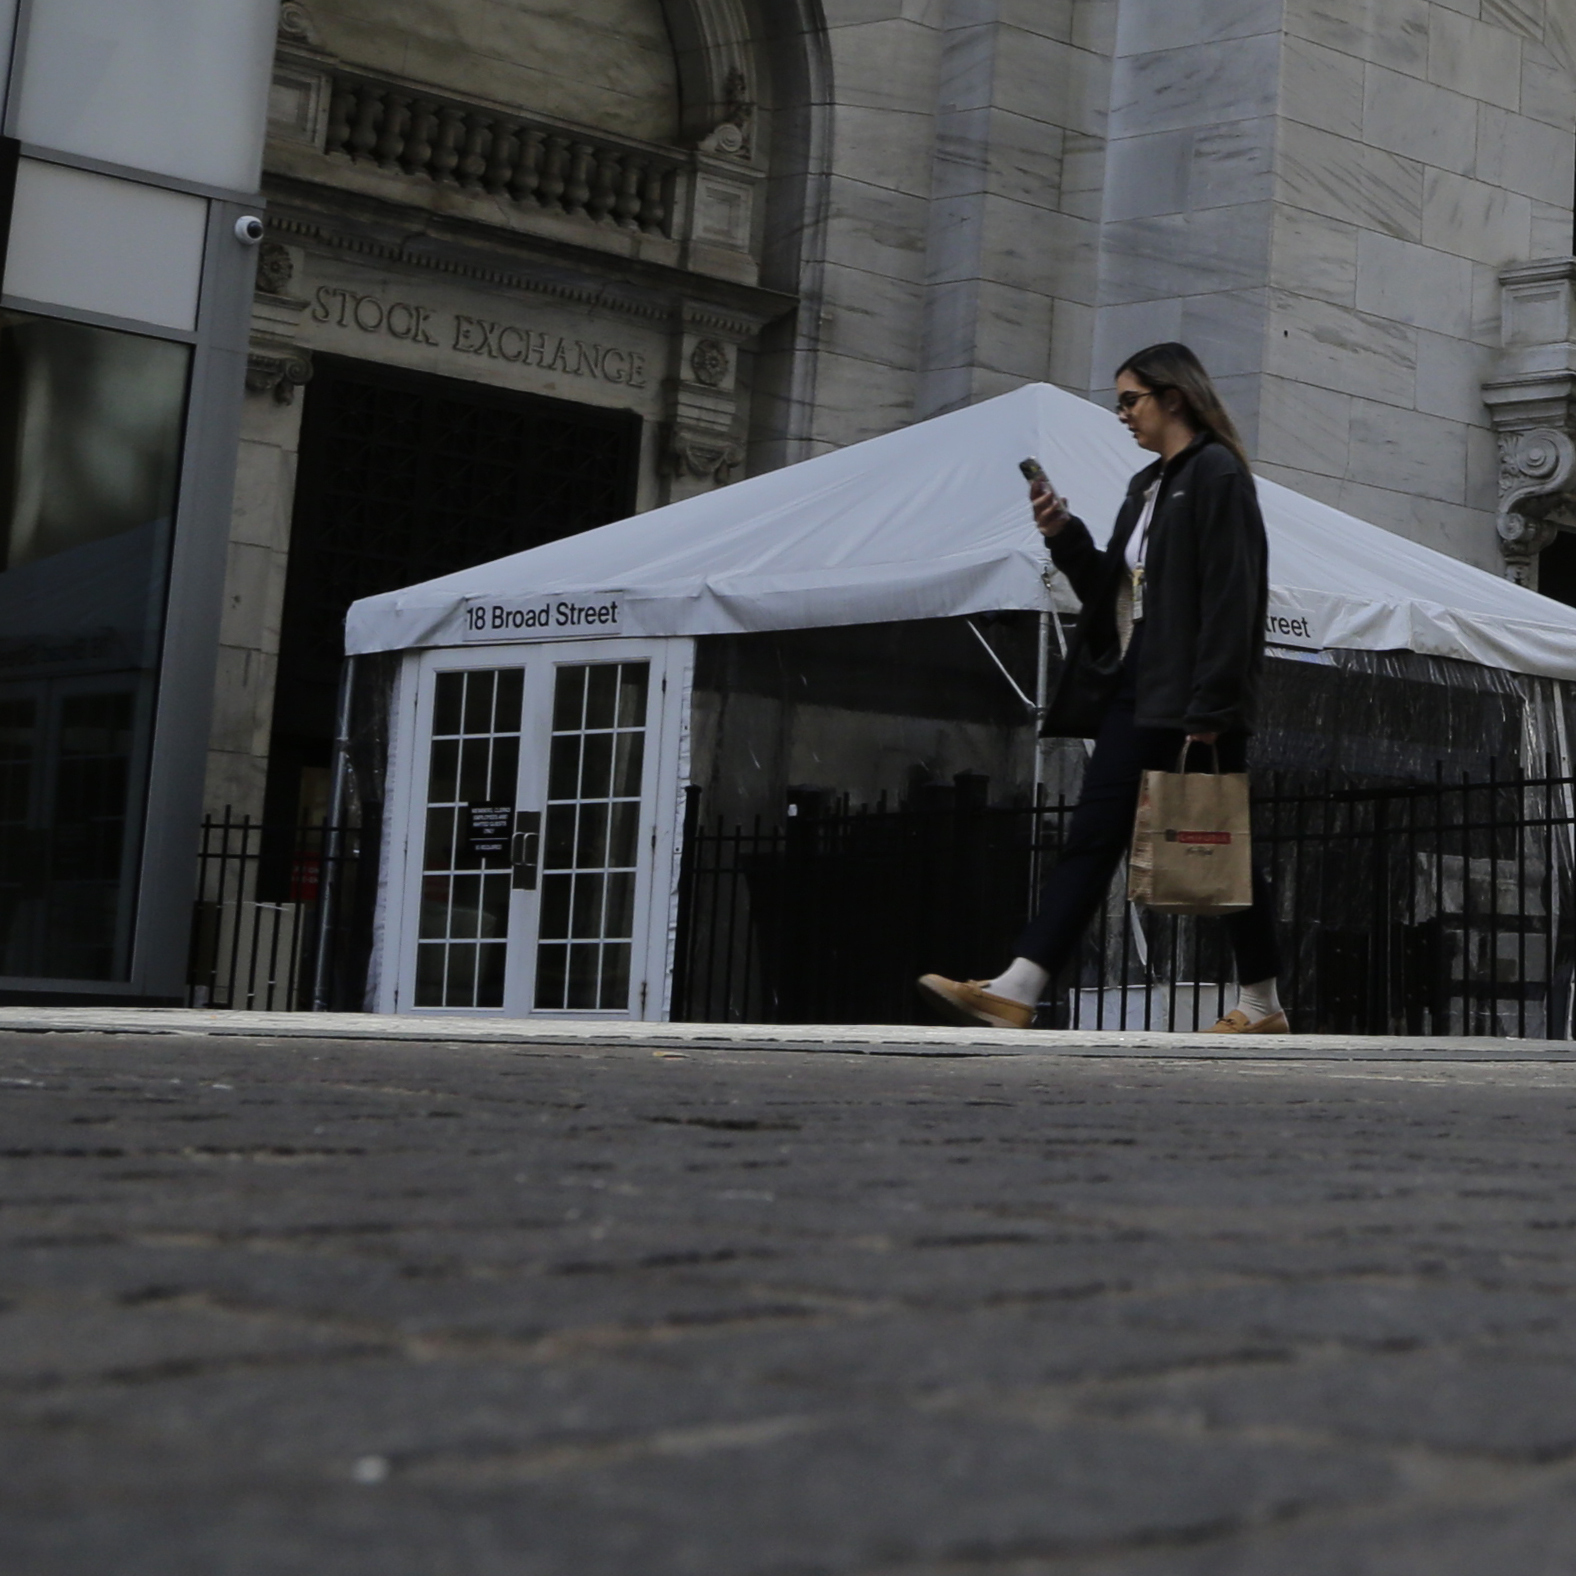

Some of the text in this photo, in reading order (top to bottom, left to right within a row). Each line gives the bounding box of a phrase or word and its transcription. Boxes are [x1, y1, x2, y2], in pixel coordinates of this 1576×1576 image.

[312, 285, 648, 388] STOCK EXCHANGE
[467, 600, 618, 631] 18 Broad Street
